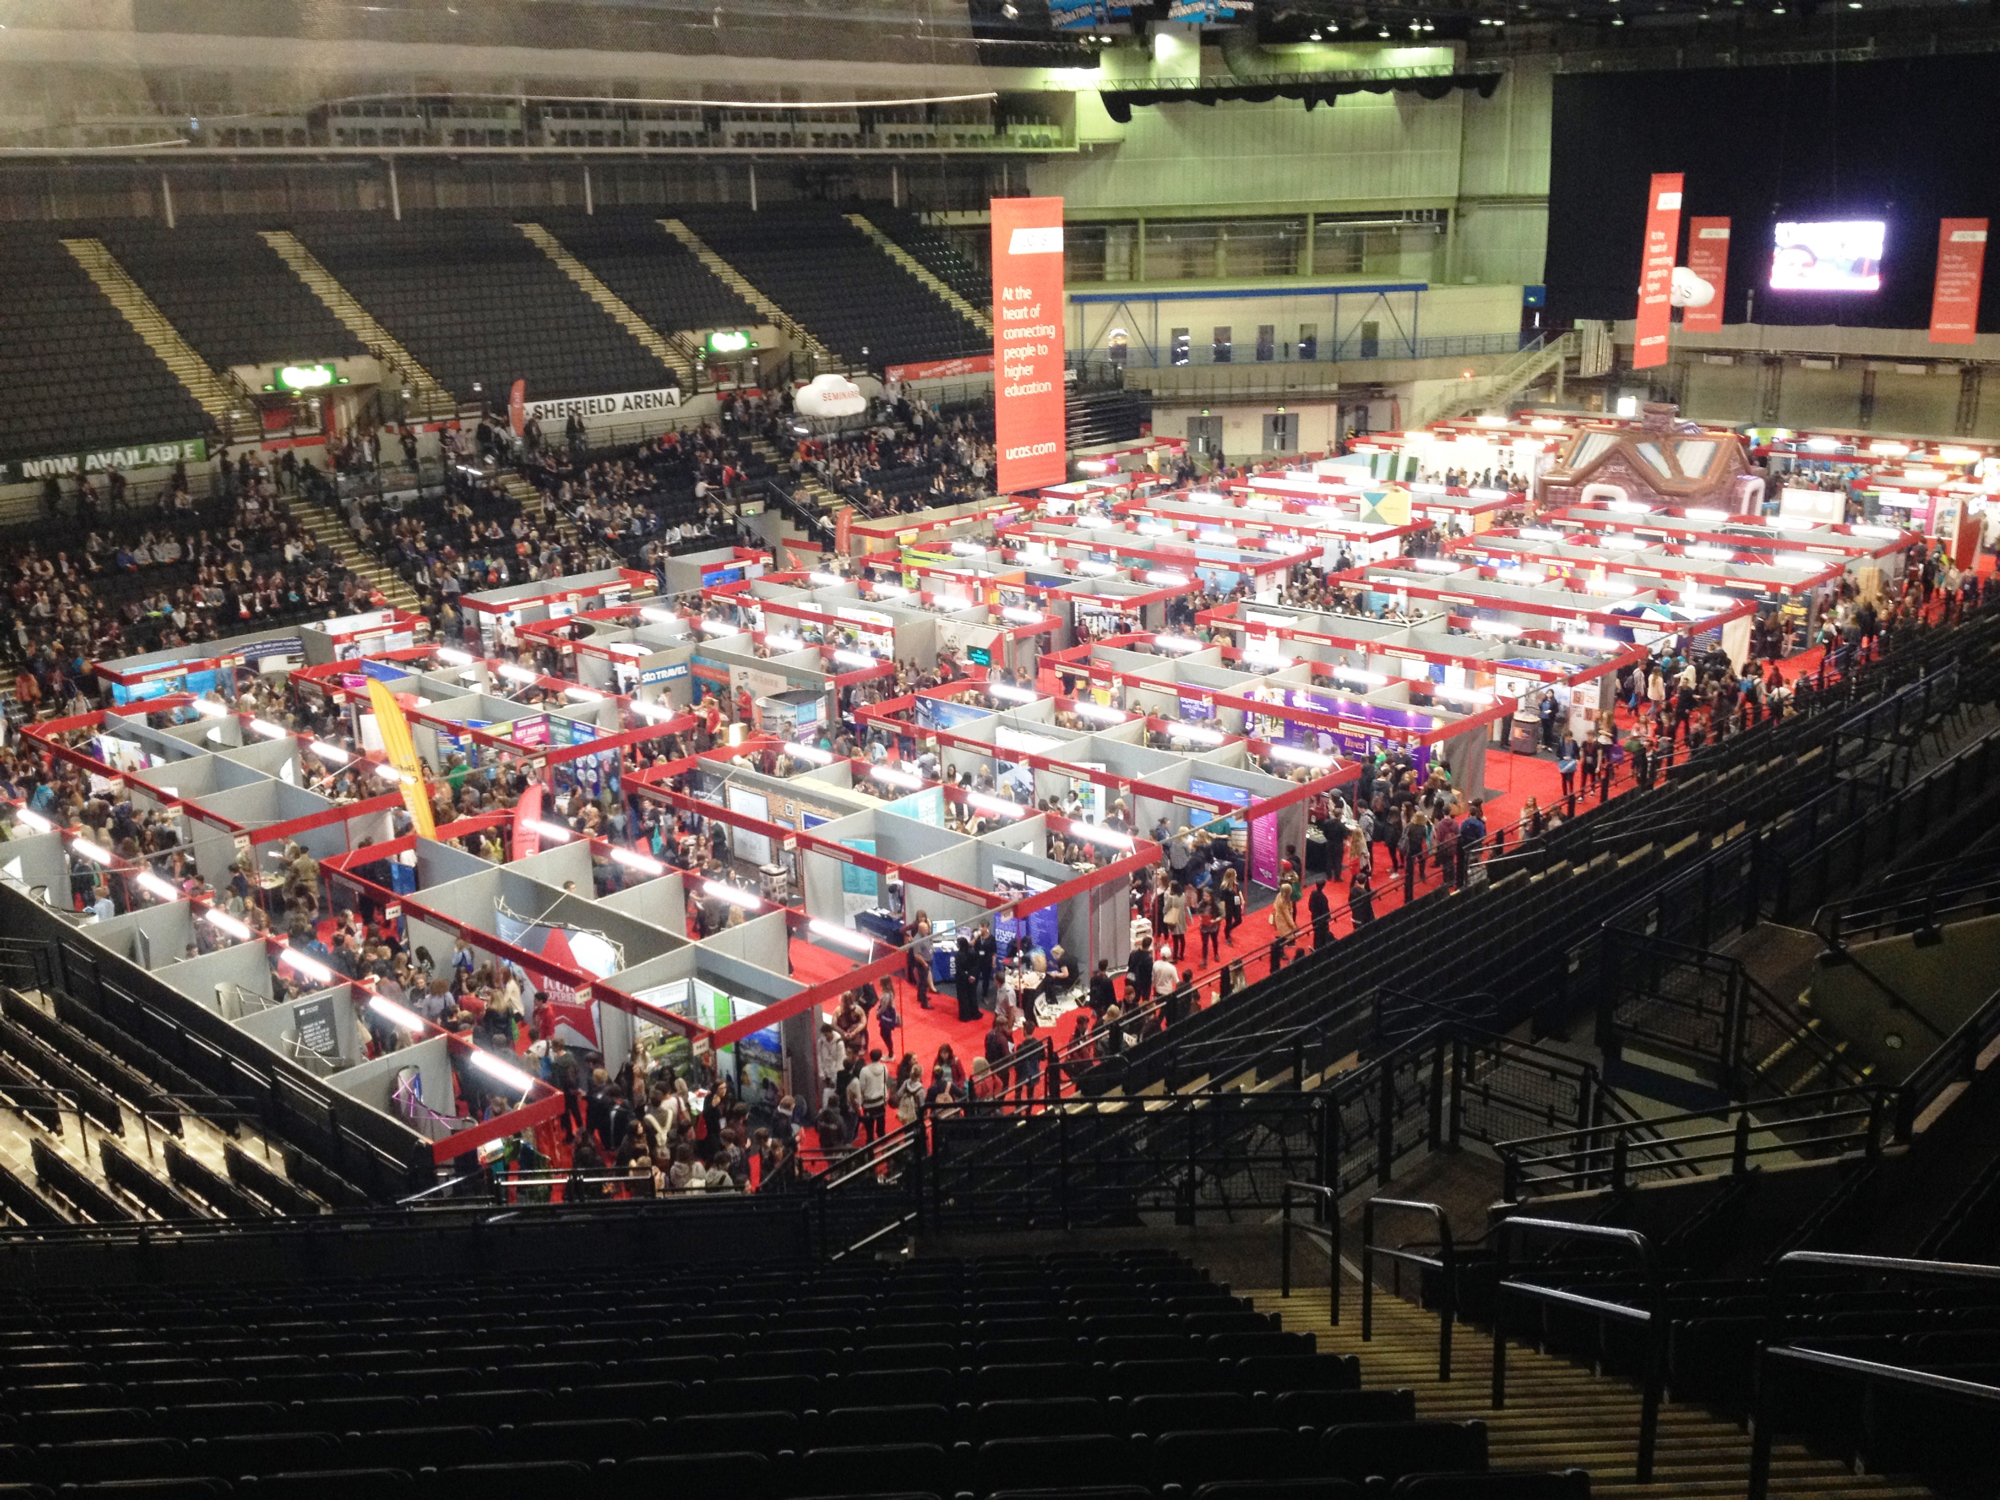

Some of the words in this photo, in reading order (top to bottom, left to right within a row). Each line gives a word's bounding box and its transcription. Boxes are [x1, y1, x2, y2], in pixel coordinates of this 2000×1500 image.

[1002, 286, 1014, 301] At
[1015, 285, 1032, 300] the
[1003, 305, 1029, 320] heart
[1029, 303, 1041, 319] of
[1003, 323, 1056, 341] connecting
[1003, 345, 1036, 363] people
[1036, 342, 1048, 357] to
[1004, 364, 1035, 381] higher
[821, 389, 861, 402] SEMINARS
[1005, 380, 1052, 398] education
[533, 397, 617, 420] SHEFFIELD
[622, 391, 676, 412] ARENA
[1006, 439, 1057, 461] ucas.com
[22, 456, 79, 478] NOW
[655, 665, 688, 680] TRAVEL
[995, 928, 1017, 939] STUDY
